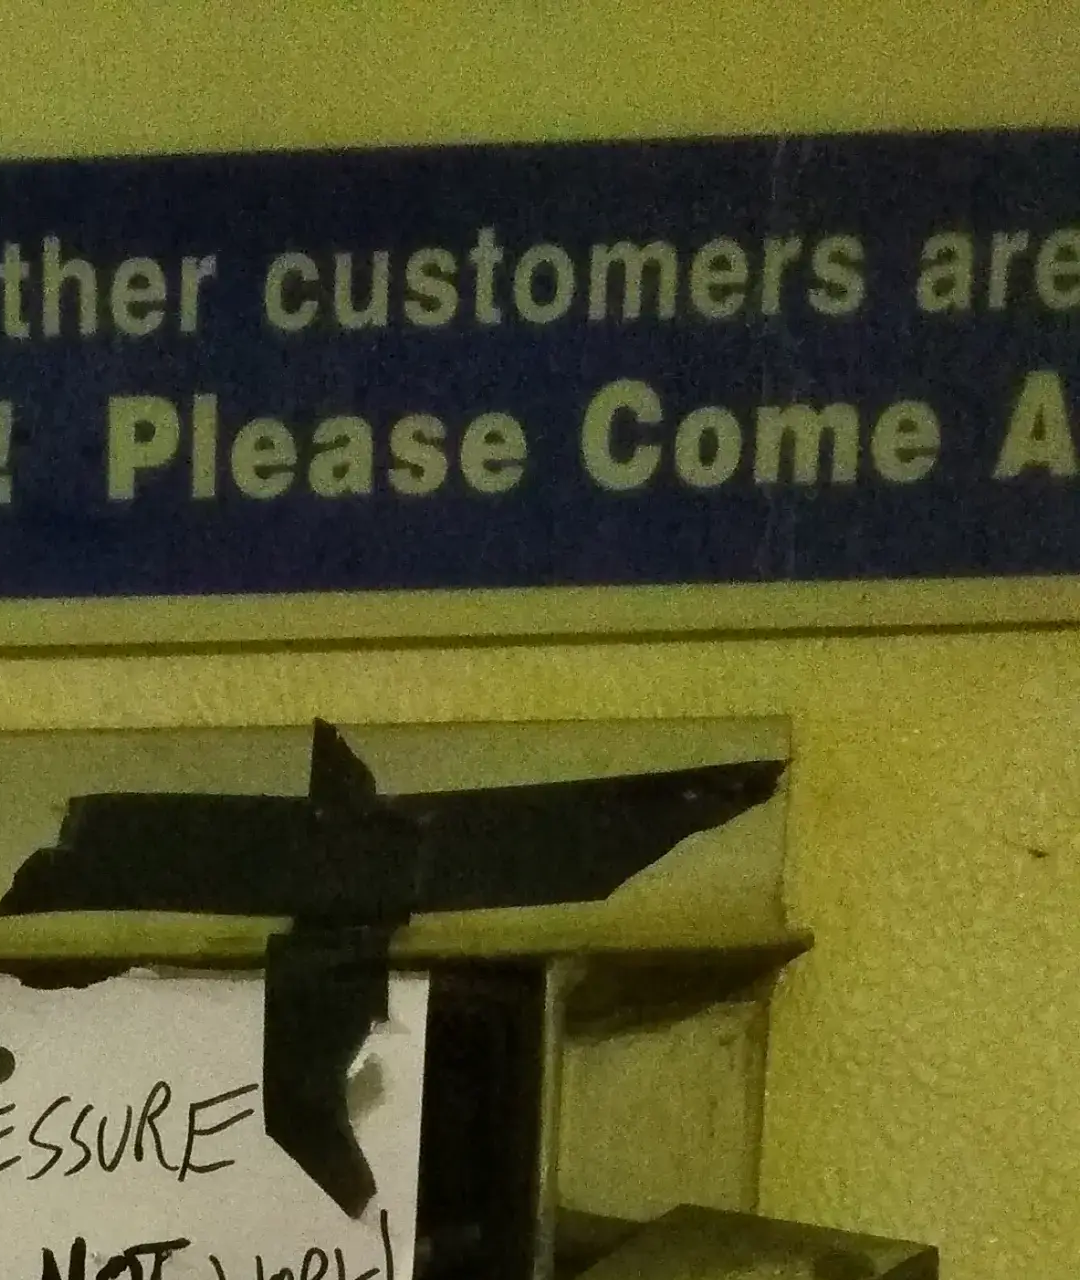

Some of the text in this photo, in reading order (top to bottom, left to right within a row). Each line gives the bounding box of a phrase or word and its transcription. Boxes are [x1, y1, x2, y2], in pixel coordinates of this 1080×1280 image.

[263, 226, 867, 334] customers
[917, 228, 1080, 313] are
[105, 392, 528, 502] Please
[580, 378, 941, 494] Come
